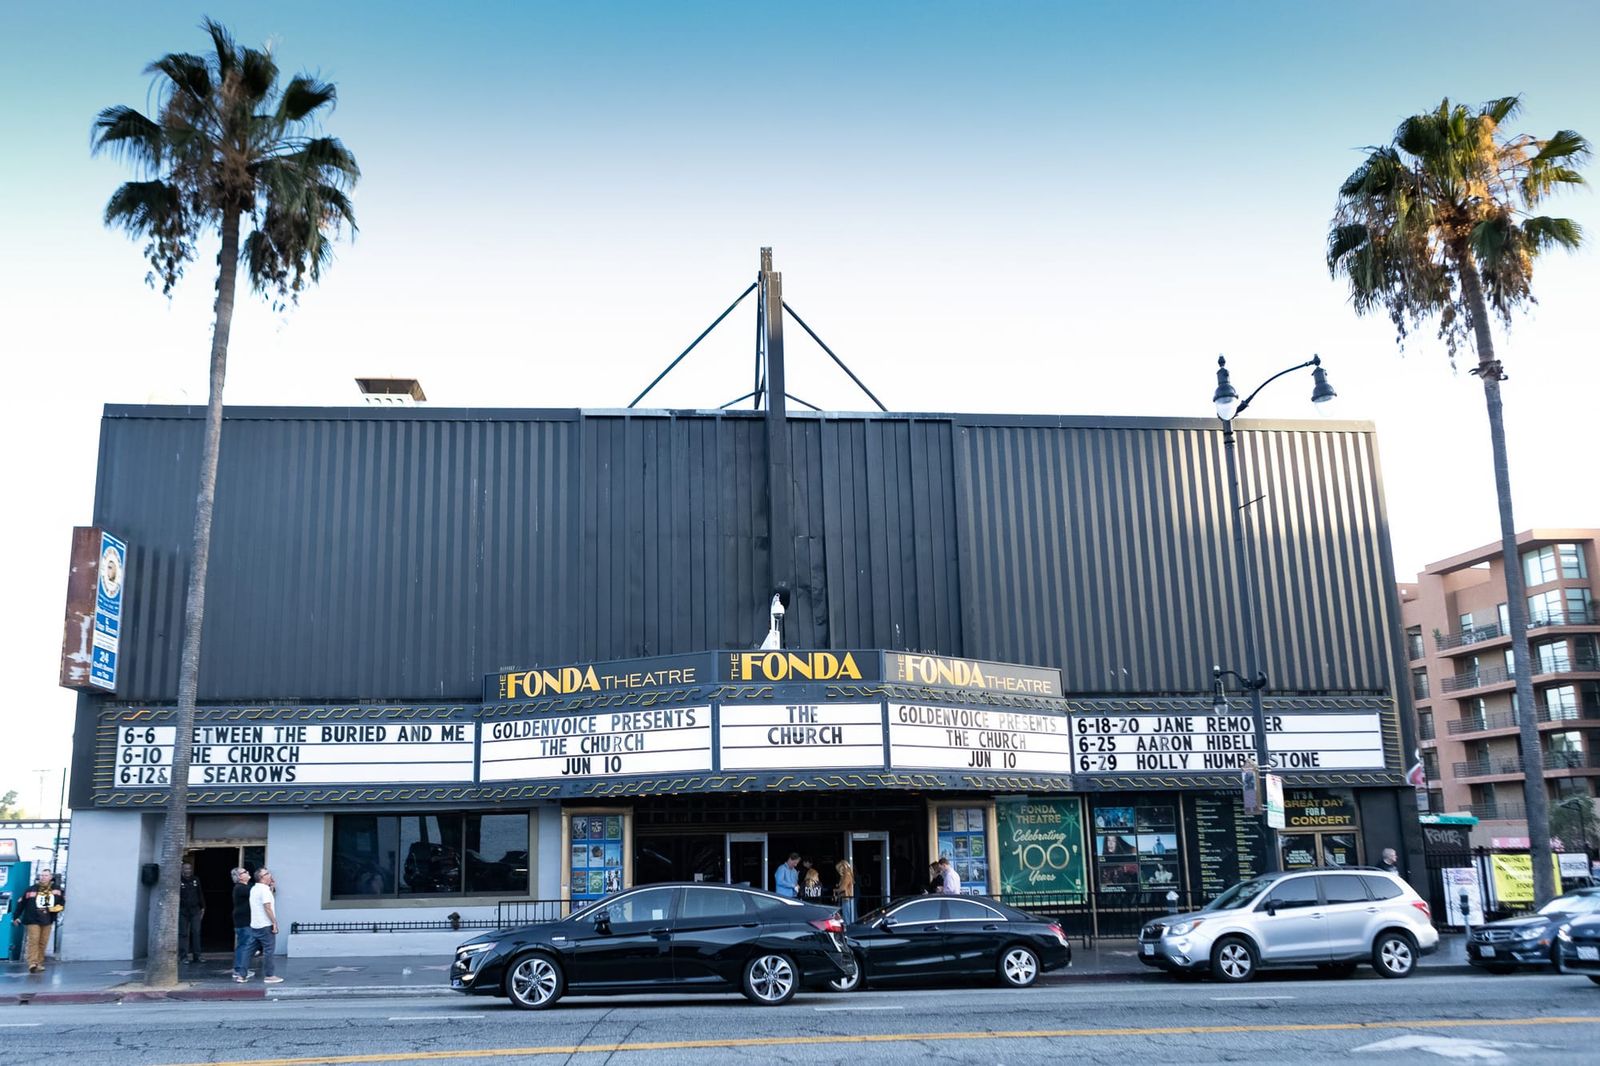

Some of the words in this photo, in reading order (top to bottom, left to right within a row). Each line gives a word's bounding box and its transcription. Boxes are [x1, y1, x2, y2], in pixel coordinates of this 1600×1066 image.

[731, 653, 739, 680] THE
[741, 652, 862, 681] FONDA
[905, 655, 986, 688] FONDA
[985, 675, 1052, 694] THEATRE
[499, 674, 507, 700] THE
[507, 665, 601, 699] FONDA
[601, 668, 696, 690] THEATRE
[493, 716, 597, 740] GOLDENVOICE
[611, 708, 696, 732] PRESENTS
[786, 705, 818, 724] THE
[899, 705, 989, 729] GOLDENVOICE
[1000, 716, 1057, 733] PRESENTS
[124, 727, 156, 744] 6-6
[192, 726, 263, 743] ETWEEN
[274, 726, 306, 743] THE
[321, 726, 386, 743] BURIED
[397, 725, 432, 743] AND
[441, 725, 465, 742] ME
[1078, 717, 1140, 734] 6-18-20
[1153, 717, 1194, 733] JANE
[1207, 716, 1283, 732] REMOER
[540, 738, 567, 757] THE
[580, 733, 644, 754] CHURCH
[767, 726, 843, 745] CHURCH
[946, 729, 970, 747] THE
[979, 731, 1026, 750] CHURCH
[1079, 736, 1116, 753] 6-25
[1136, 735, 1193, 751] AARON
[122, 747, 162, 764] 6-10
[190, 747, 212, 763] HE
[228, 745, 300, 763] CHURCH
[968, 750, 992, 768] JUN
[1003, 752, 1017, 769] 10
[1080, 754, 1117, 771] 6-29
[1136, 753, 1189, 770] HOLLY
[204, 766, 296, 783] SEAROWS
[562, 756, 591, 775] JUN
[605, 755, 622, 774] 10
[1020, 805, 1056, 814] FONDA
[1284, 799, 1320, 808] GREAT
[1322, 799, 1345, 807] DAY
[1305, 807, 1319, 816] FOR
[1320, 807, 1326, 816] A
[1016, 814, 1061, 824] THEATRE
[1291, 816, 1351, 825] CONCERT
[1013, 829, 1067, 846] Celebrating
[1012, 844, 1070, 870] 100
[1028, 870, 1056, 885] Years
